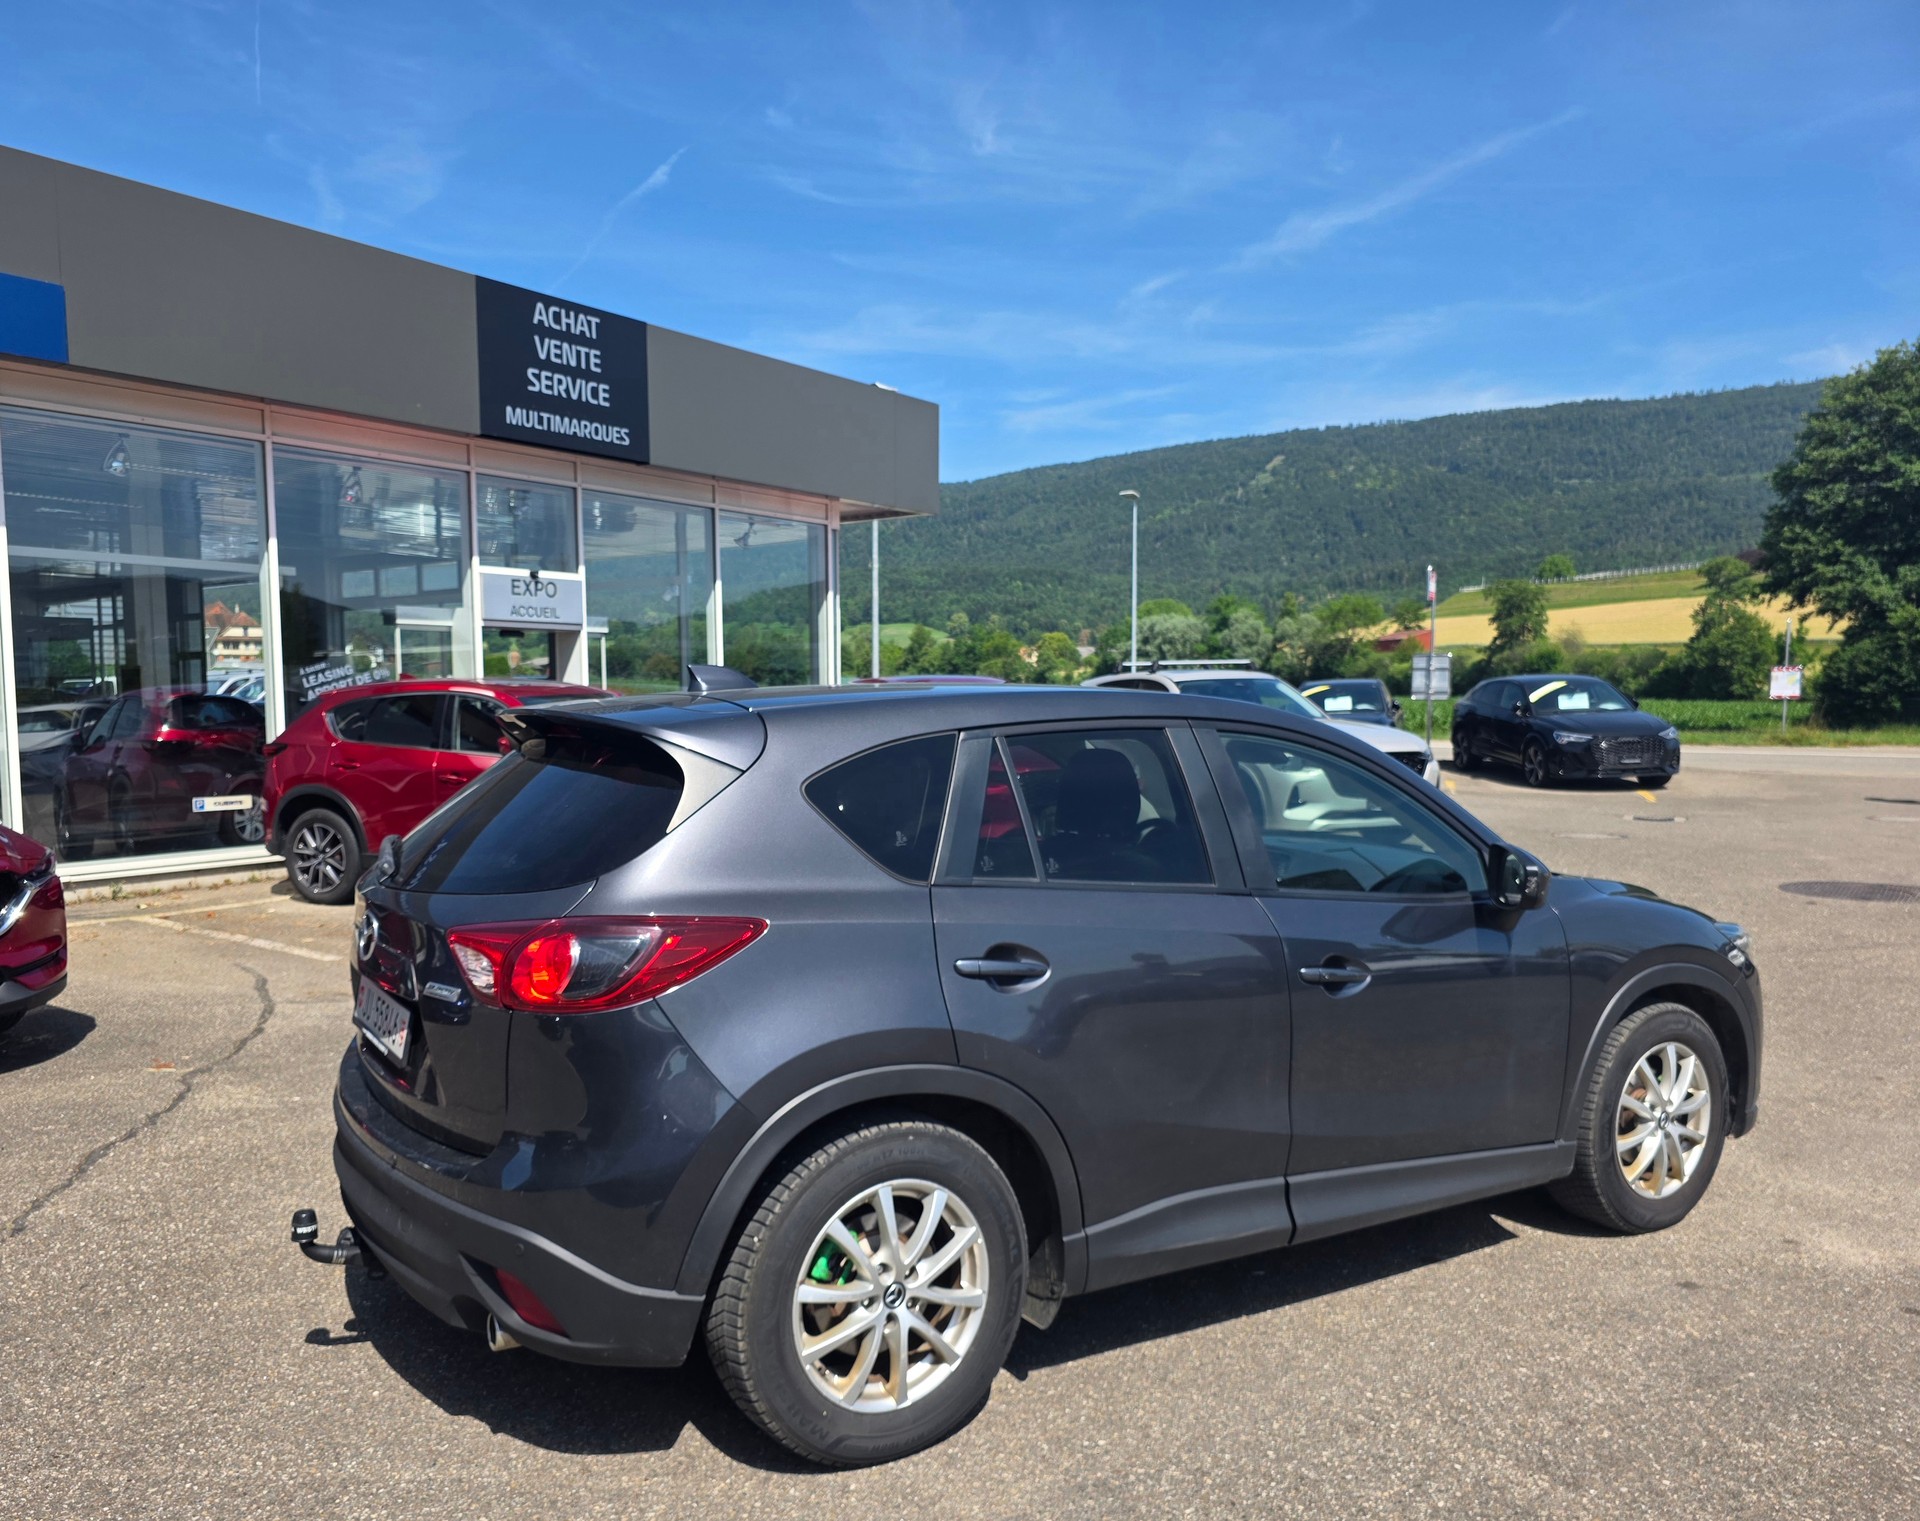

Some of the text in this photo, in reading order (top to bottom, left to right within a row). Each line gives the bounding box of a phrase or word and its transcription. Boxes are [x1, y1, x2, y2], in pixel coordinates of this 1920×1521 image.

[533, 302, 600, 340] ACHAT
[534, 335, 602, 373] VENTE
[526, 367, 611, 408] SERVICE
[505, 405, 630, 446] MULTIMARQUES
[511, 579, 558, 599] EXPO
[510, 605, 560, 619] ACCUEIL
[302, 664, 354, 688] LEASING
[356, 672, 372, 686] DE
